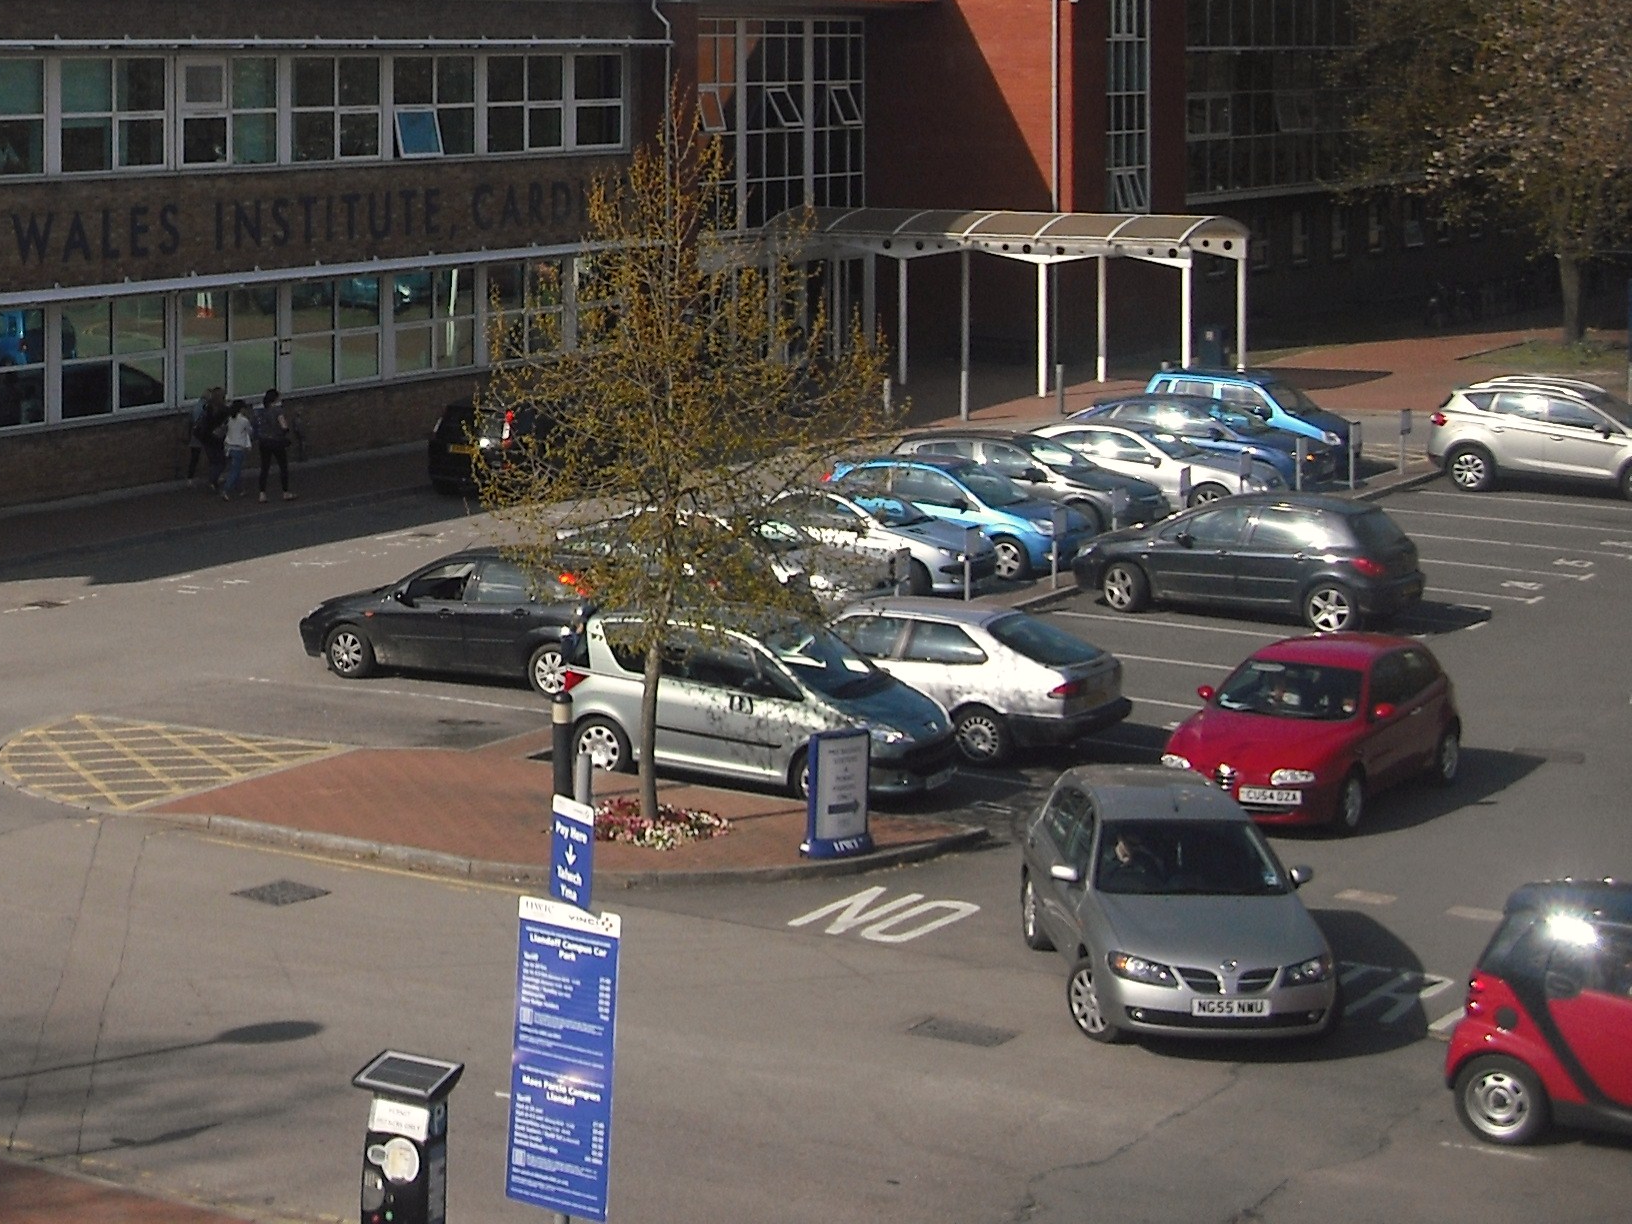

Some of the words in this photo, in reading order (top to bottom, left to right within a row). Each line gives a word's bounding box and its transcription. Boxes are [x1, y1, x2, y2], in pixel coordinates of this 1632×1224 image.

[11, 202, 181, 265] WALES
[473, 179, 628, 232] CARDI
[555, 820, 570, 840] Pay
[570, 826, 588, 845] Here
[787, 885, 981, 943] NO
[558, 949, 576, 962] Park
